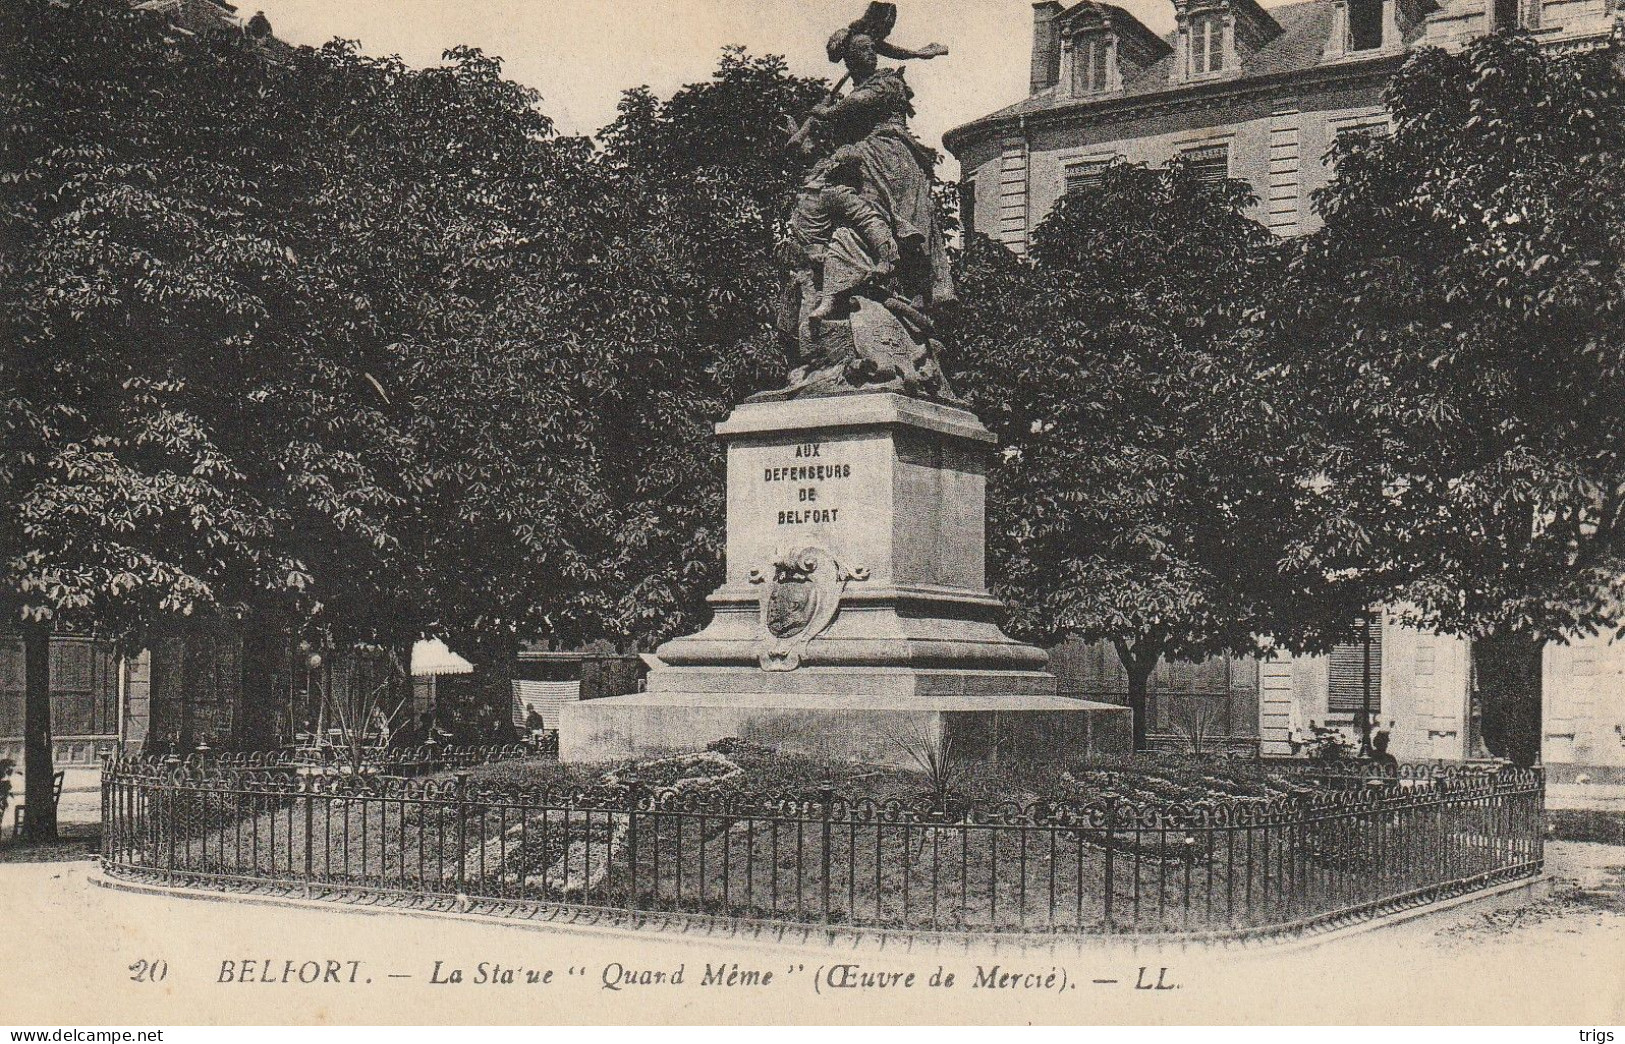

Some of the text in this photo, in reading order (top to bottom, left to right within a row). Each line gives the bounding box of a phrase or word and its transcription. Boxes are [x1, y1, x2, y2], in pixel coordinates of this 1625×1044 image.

[795, 444, 820, 458] AUX
[764, 464, 851, 482] DEFENSEURS
[799, 488, 816, 502] DE
[778, 508, 839, 525] BELFORT
